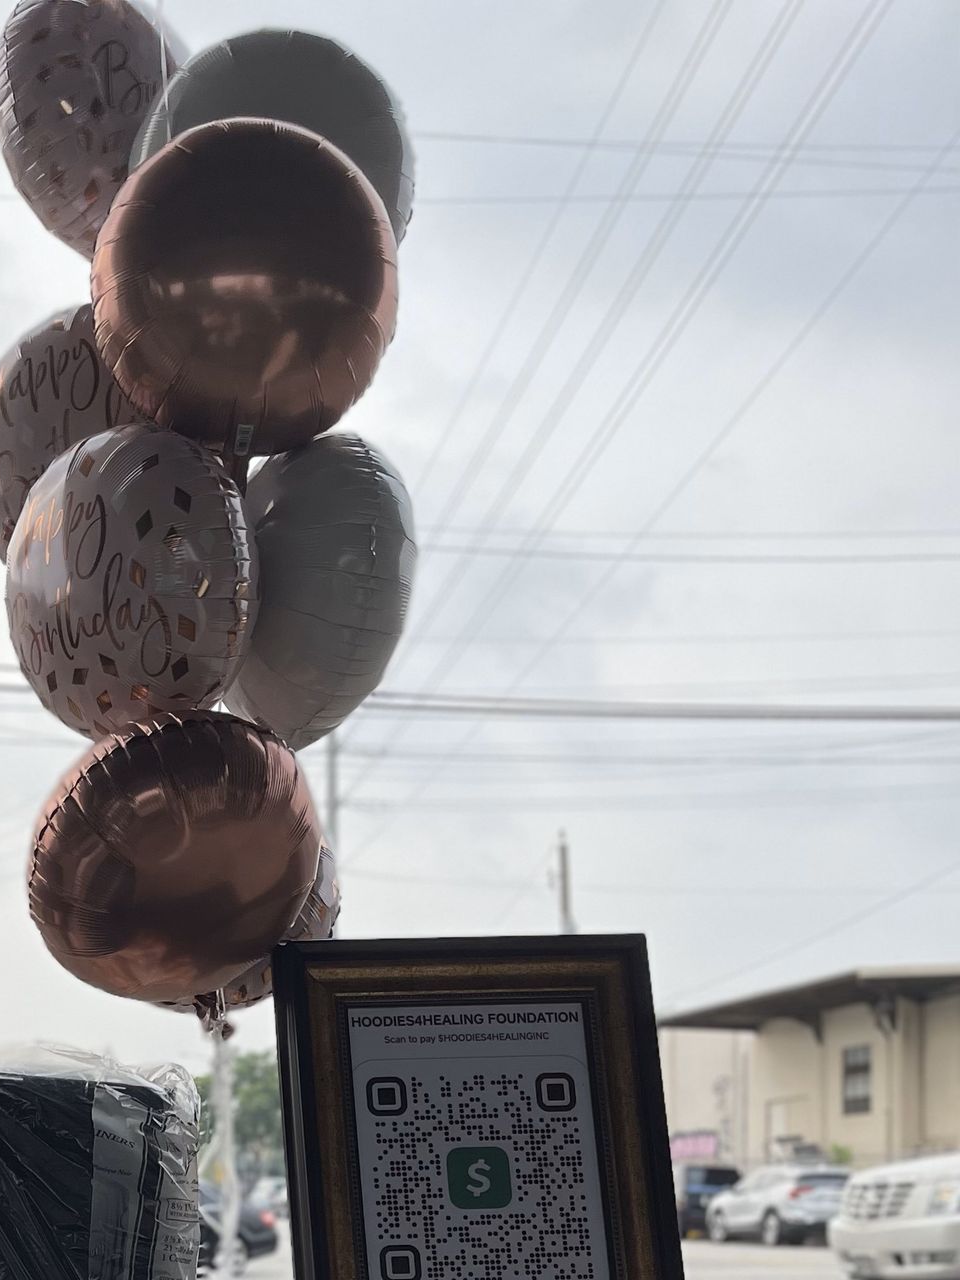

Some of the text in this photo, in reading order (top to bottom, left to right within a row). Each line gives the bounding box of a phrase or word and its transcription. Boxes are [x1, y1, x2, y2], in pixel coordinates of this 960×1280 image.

[351, 1011, 579, 1028] HOODIES4HEALING FOUNDATION
[384, 1035, 407, 1044] Scan
[408, 1035, 418, 1043] to
[419, 1036, 436, 1045] pay
